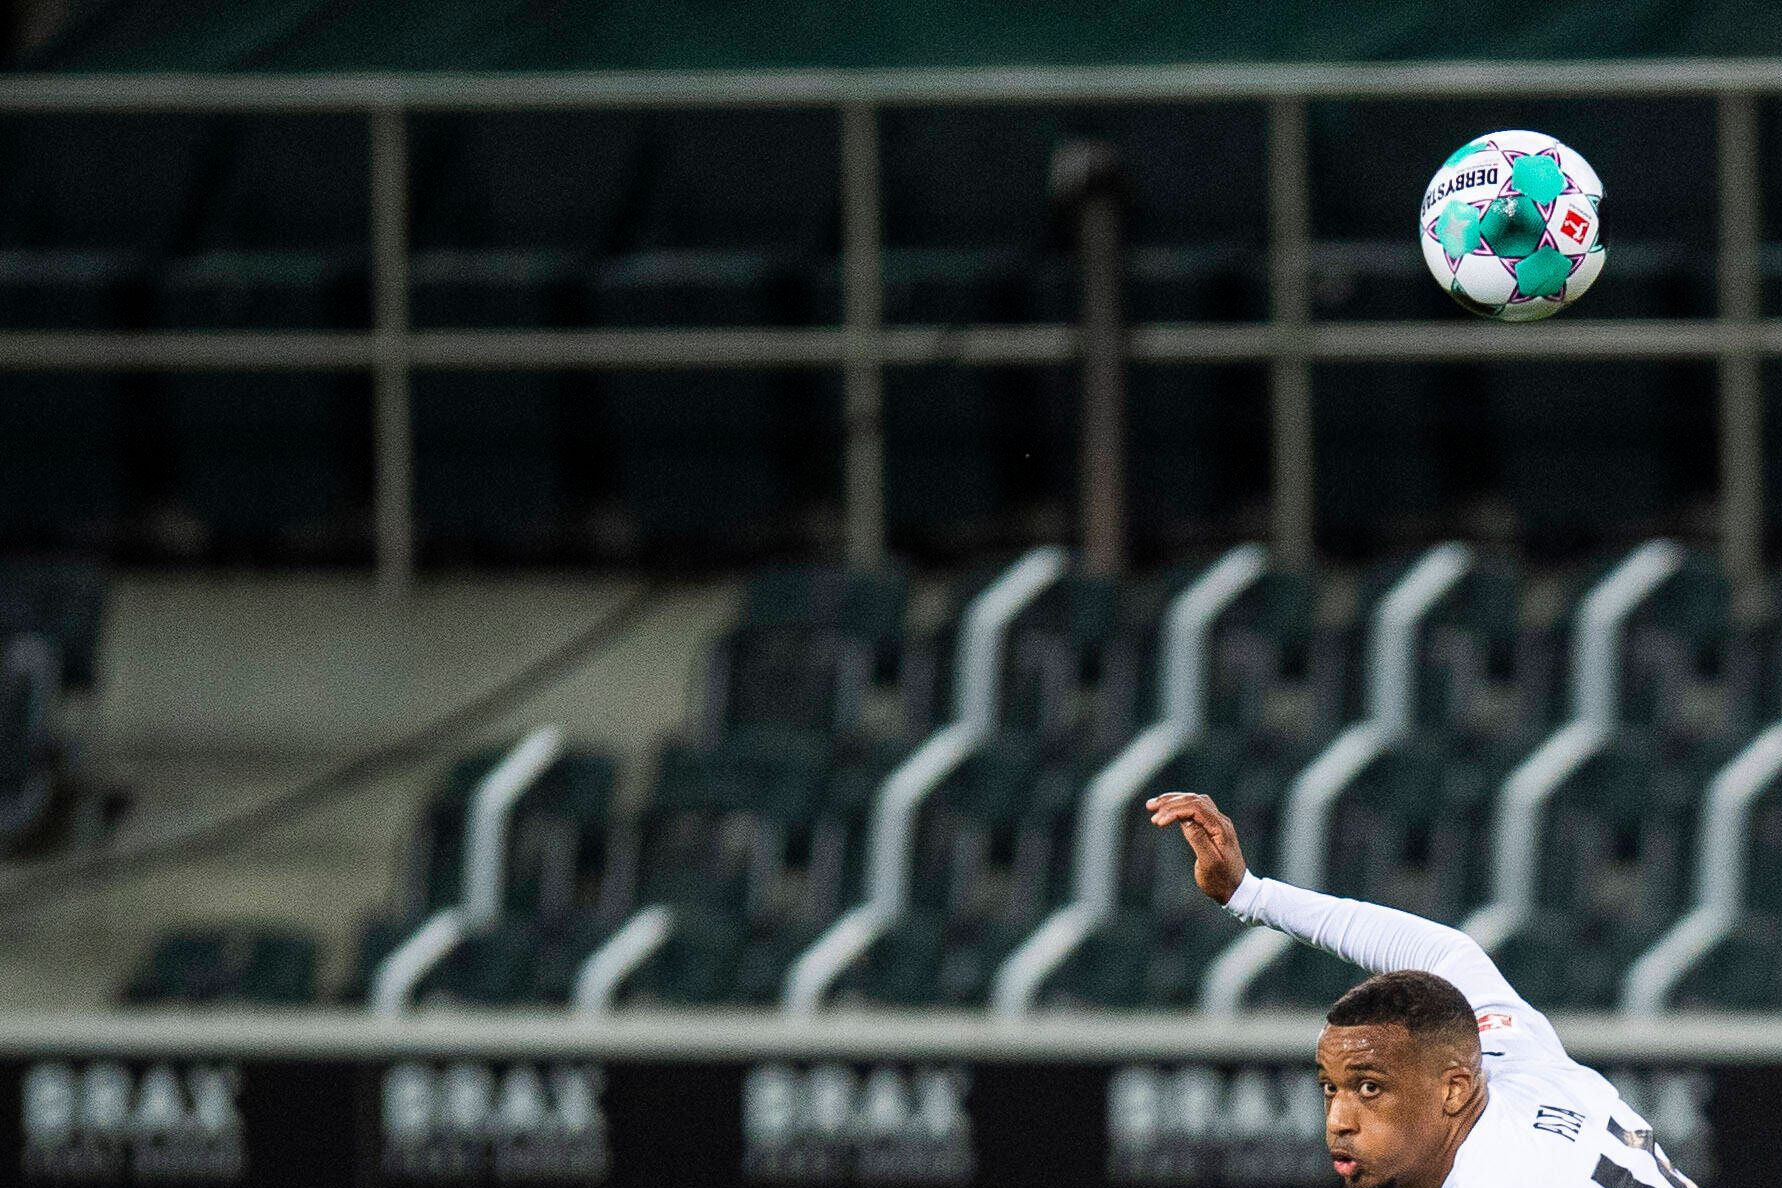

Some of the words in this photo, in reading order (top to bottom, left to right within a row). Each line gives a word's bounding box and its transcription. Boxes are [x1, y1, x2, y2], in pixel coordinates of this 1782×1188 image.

[23, 1064, 242, 1136] BRAX
[382, 1064, 603, 1137] BRAX
[743, 1066, 972, 1140] BRAX
